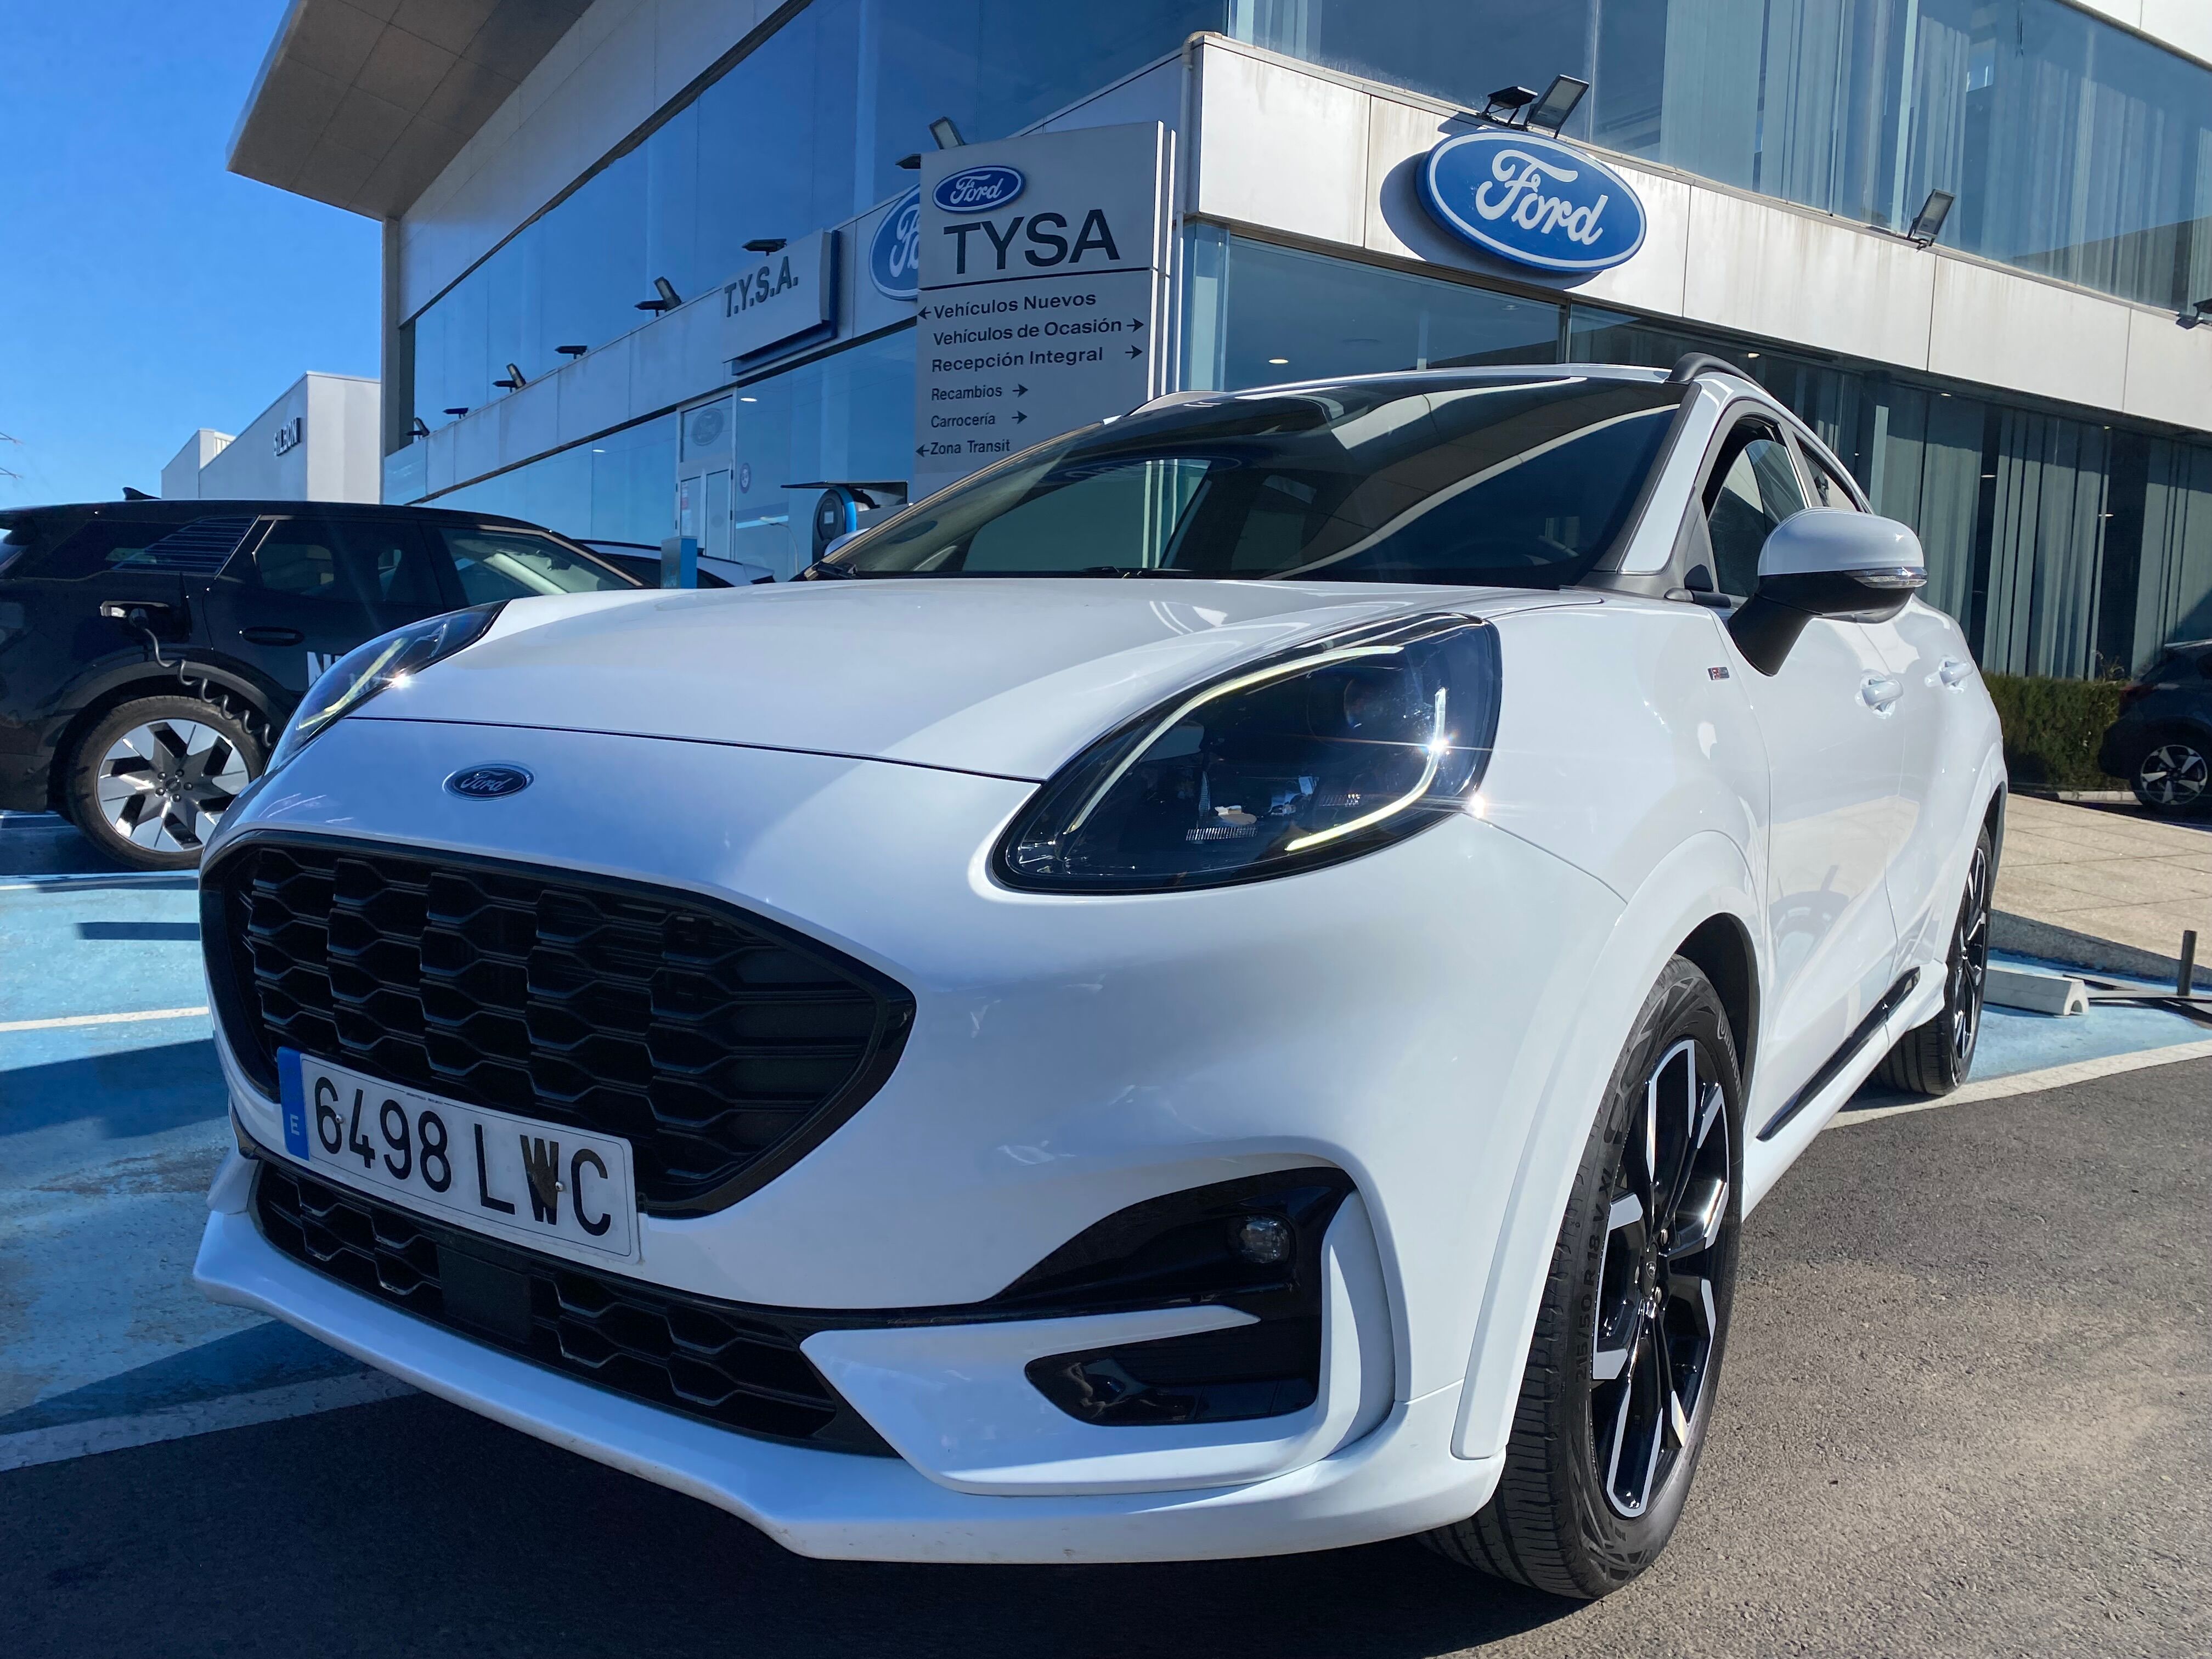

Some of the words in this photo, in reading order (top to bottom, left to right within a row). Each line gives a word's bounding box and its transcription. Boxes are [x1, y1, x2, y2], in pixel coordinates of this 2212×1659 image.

[949, 172, 1003, 203] Ford
[1476, 150, 1608, 245] Ford
[943, 208, 1120, 274] TYSA
[724, 255, 799, 318] T.Y.S.A.
[934, 297, 1018, 319] Vehículos
[1024, 292, 1097, 310] Nuevos
[934, 324, 1014, 346] Vehículos
[1017, 323, 1040, 339] de
[1045, 317, 1122, 336] Ocasión
[932, 352, 1024, 373] Recepción
[1030, 347, 1103, 367] Integral
[931, 385, 1003, 401] Recambios
[931, 411, 996, 428] Carrocería
[930, 441, 962, 455] Zona
[967, 439, 1011, 454] Transit
[460, 770, 514, 792] Ford
[290, 1114, 300, 1136] E
[314, 1076, 452, 1193] 6498
[474, 1123, 612, 1237] LWC
[1598, 1167, 1615, 1195] XL
[1593, 1202, 1605, 1223] V
[1587, 1233, 1601, 1262] 18
[1583, 1267, 1597, 1287] R
[1574, 1294, 1594, 1385] 215/50
